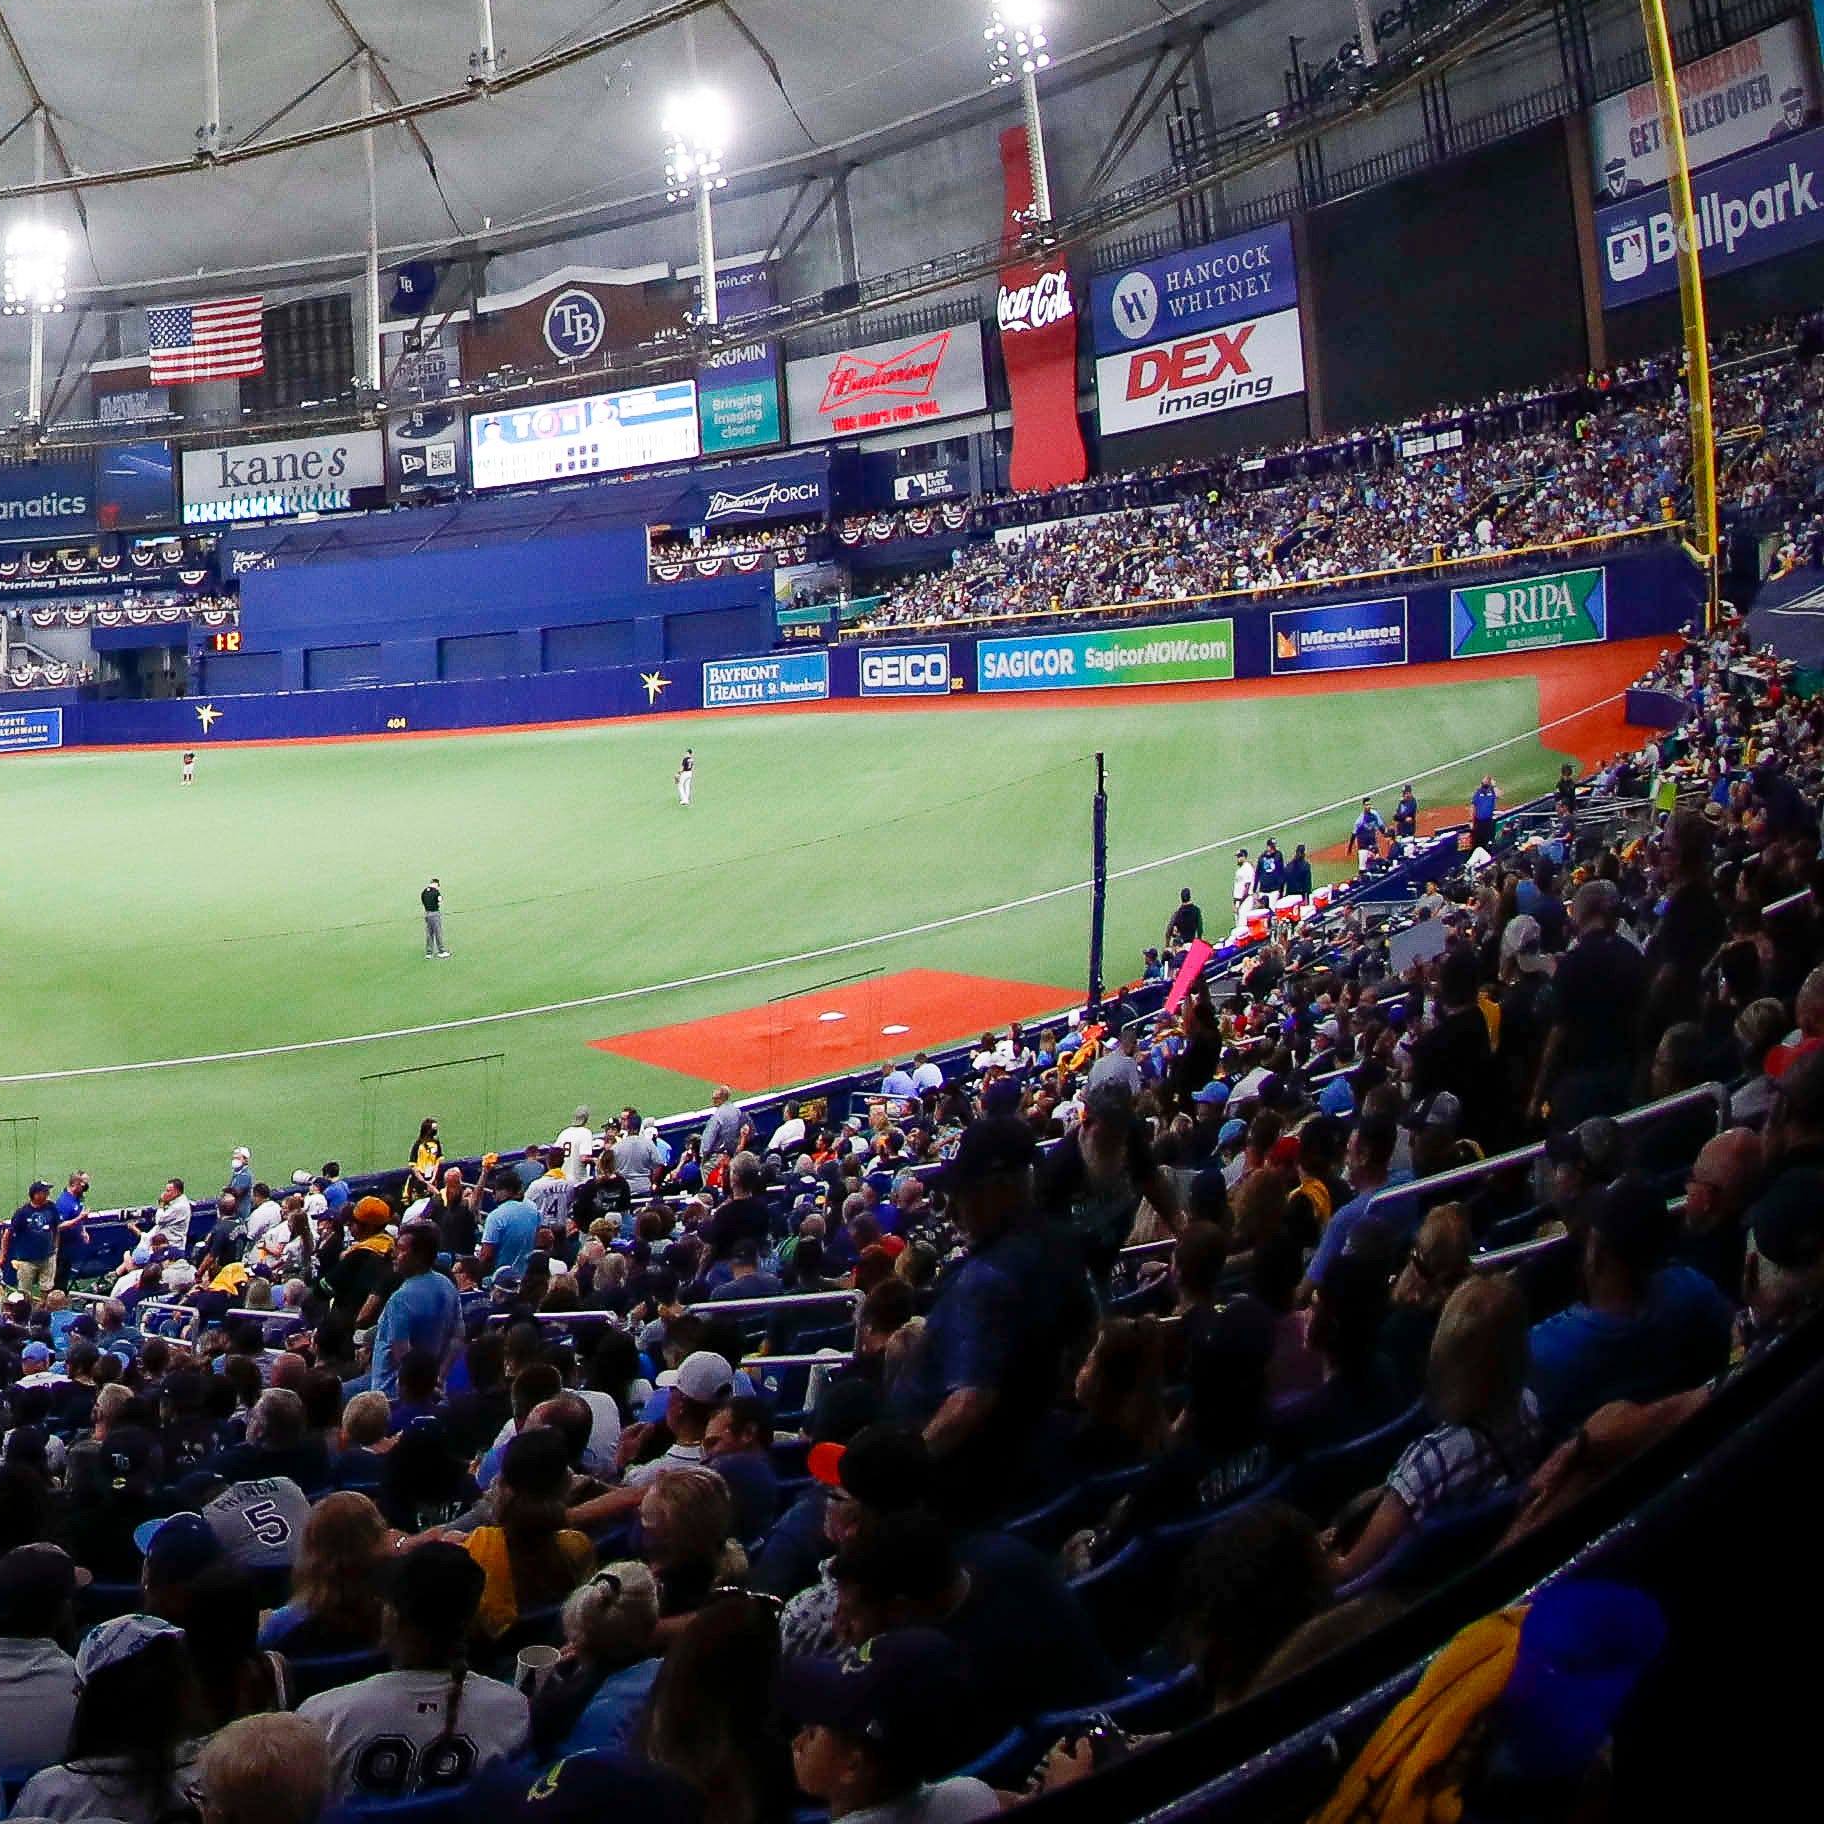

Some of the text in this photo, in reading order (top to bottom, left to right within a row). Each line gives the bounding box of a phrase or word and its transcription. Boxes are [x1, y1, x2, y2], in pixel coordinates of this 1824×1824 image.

[1167, 245, 1272, 292] HANCOCK
[1168, 271, 1273, 319] WHITNEY
[554, 303, 597, 346] TB
[1126, 324, 1257, 403] DEX
[712, 392, 763, 413] Bringing
[1158, 375, 1274, 417] imaging
[720, 423, 757, 441] closer
[217, 446, 348, 489] kane's
[770, 482, 820, 504] PORCH
[1503, 580, 1578, 627] RIPA
[1300, 624, 1401, 647] MicroLumen
[708, 664, 780, 684] BAYFRONT
[862, 653, 947, 689] GEICO
[983, 637, 1228, 679] SAGICOR SagicorNOW.com
[708, 681, 763, 701] HEALTH
[241, 1498, 292, 1547] 5
